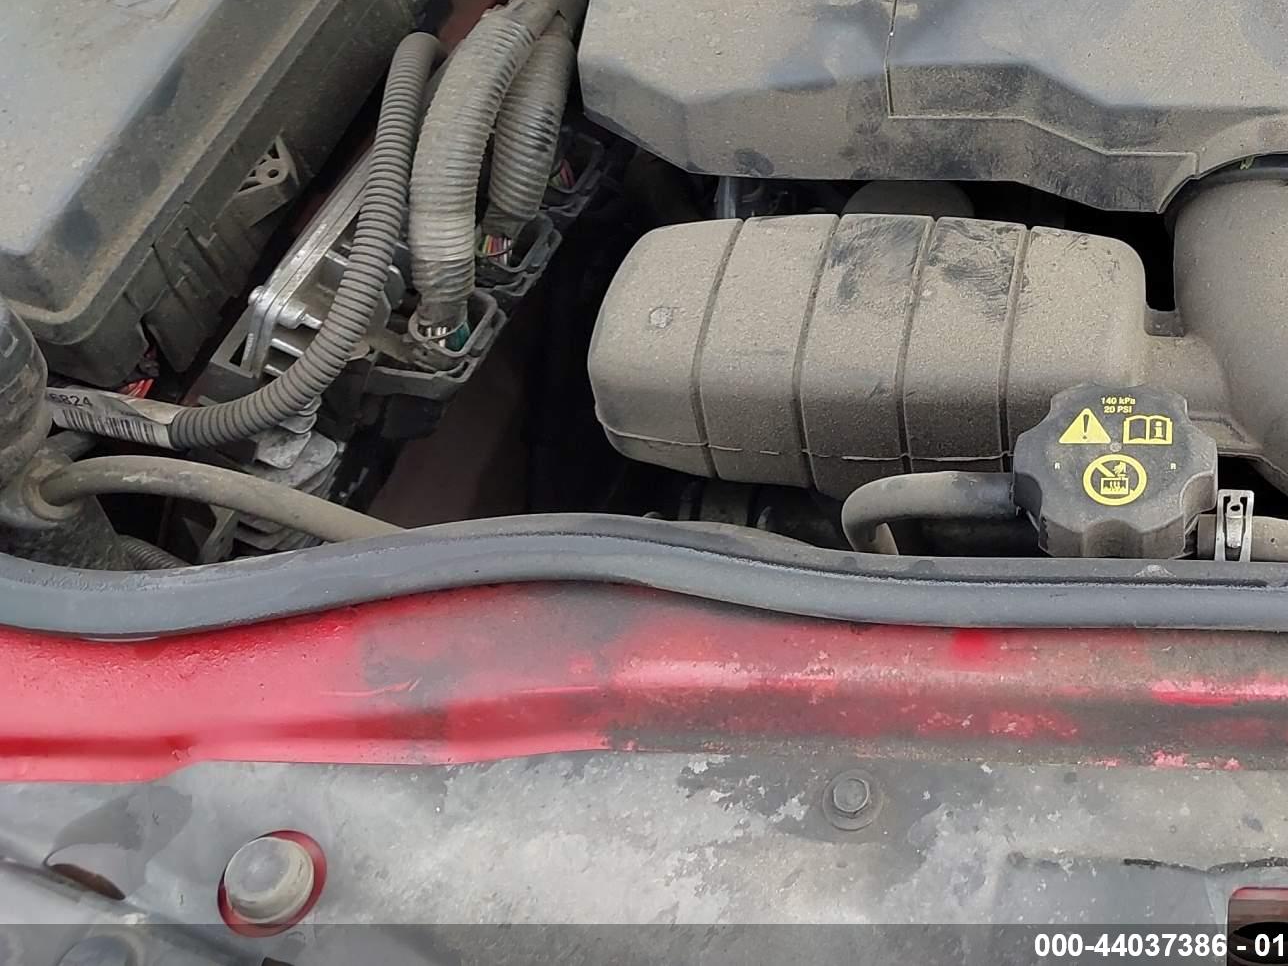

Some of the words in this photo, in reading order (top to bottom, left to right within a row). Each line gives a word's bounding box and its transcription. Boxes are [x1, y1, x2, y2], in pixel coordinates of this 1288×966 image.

[1101, 396, 1117, 405] 140
[1119, 396, 1136, 405] kPa
[1103, 405, 1115, 414] 20
[1117, 405, 1132, 414] PSI
